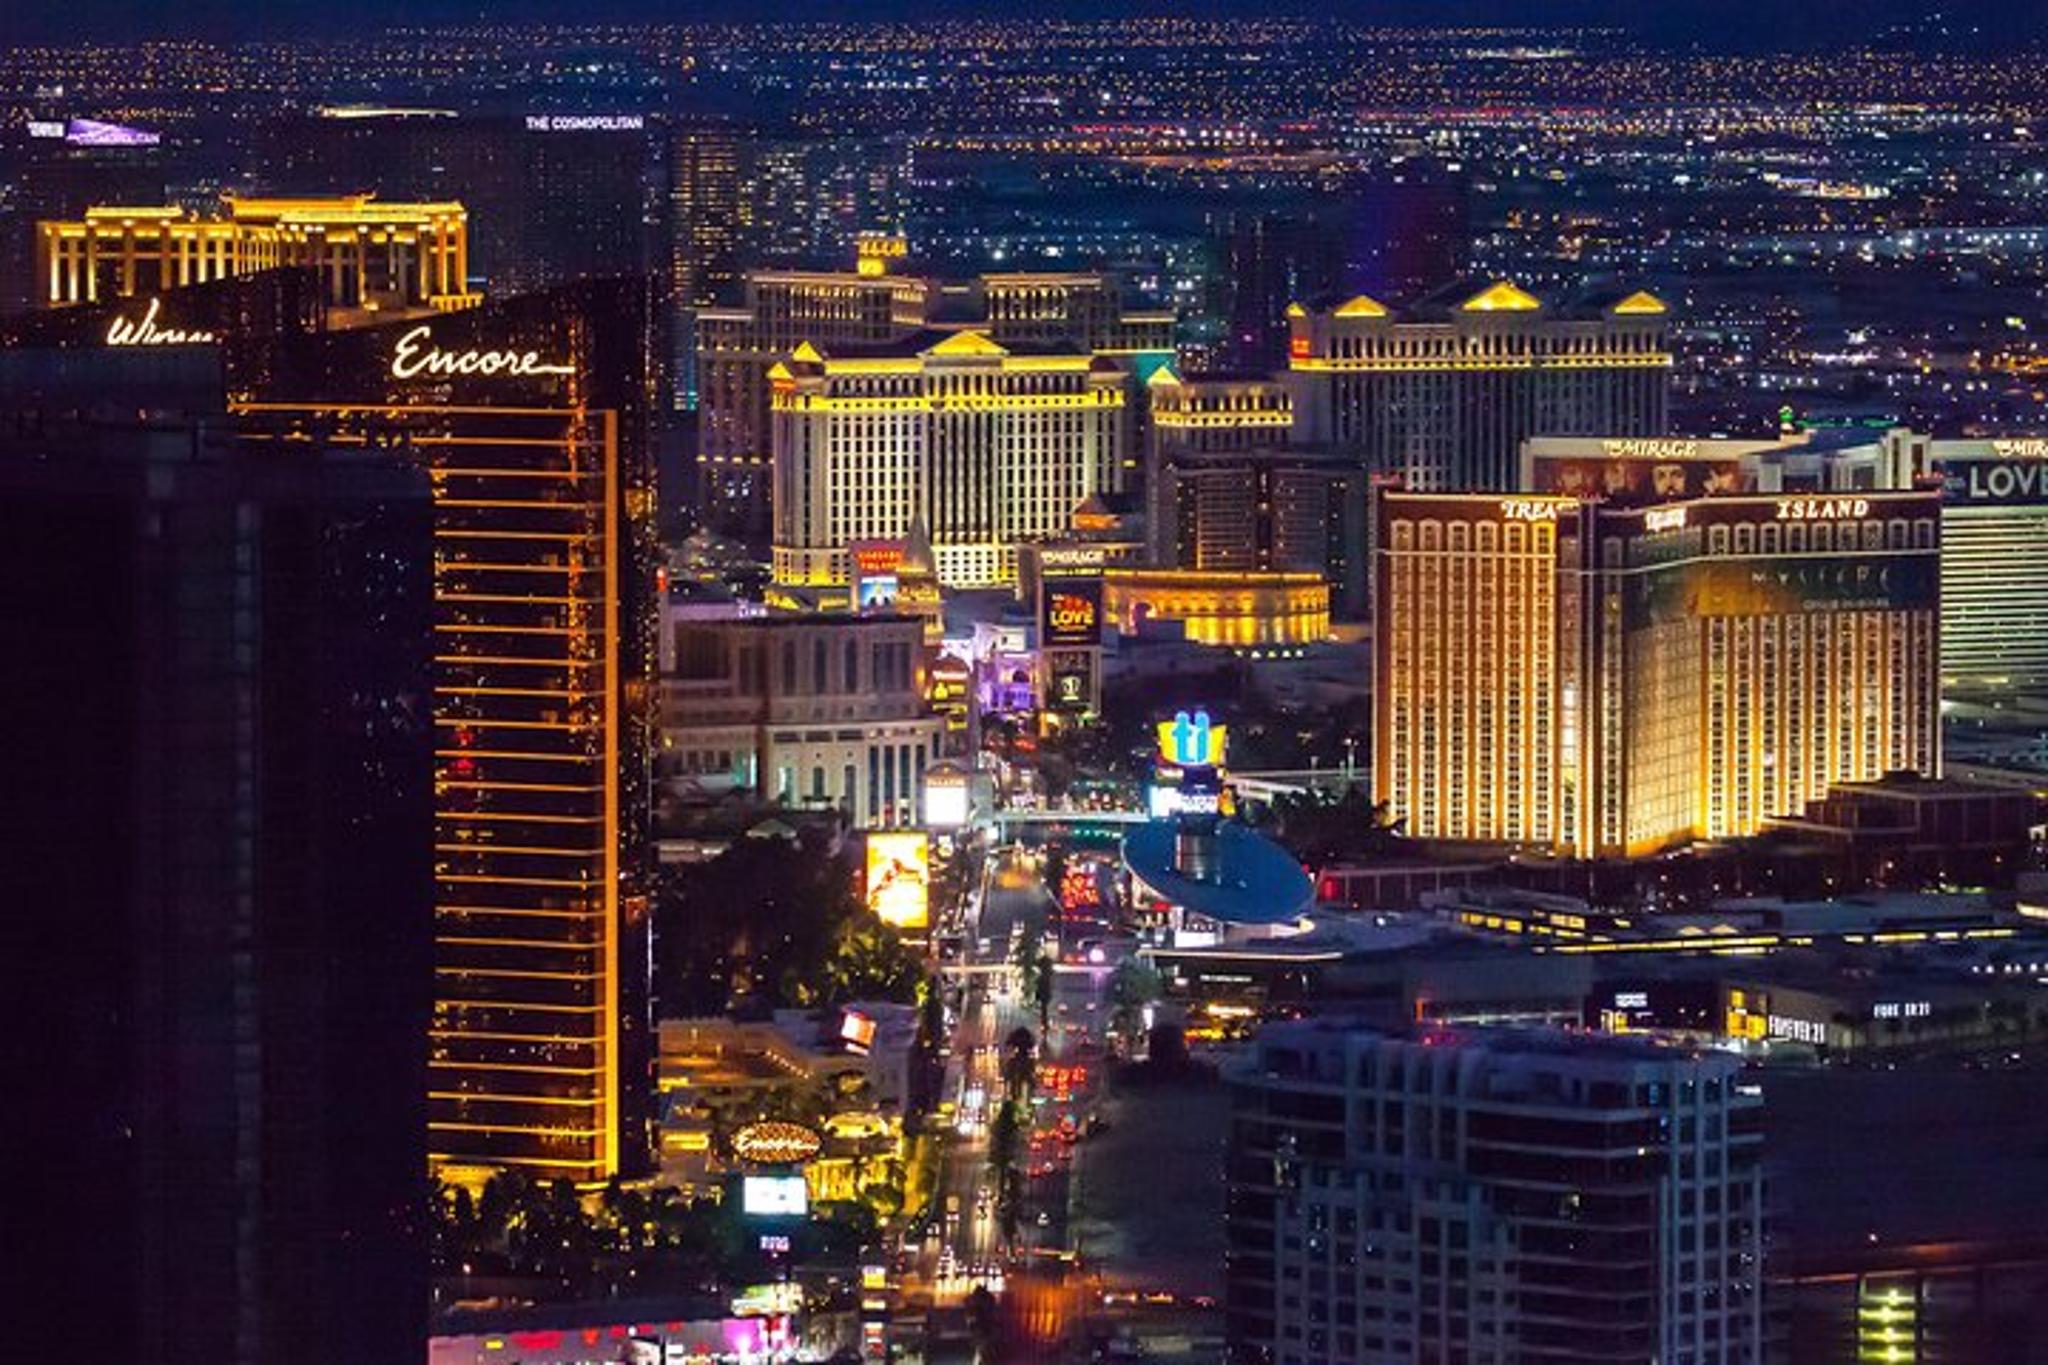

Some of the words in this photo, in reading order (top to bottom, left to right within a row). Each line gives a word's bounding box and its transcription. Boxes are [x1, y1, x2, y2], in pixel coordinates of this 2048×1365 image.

[525, 116, 550, 131] THE
[551, 116, 644, 130] COSMOPOLITAN
[392, 325, 576, 379] Encore
[1620, 440, 1697, 458] MIRAGE
[1776, 500, 1870, 519] ISLAND
[1050, 609, 1094, 626] LOVE
